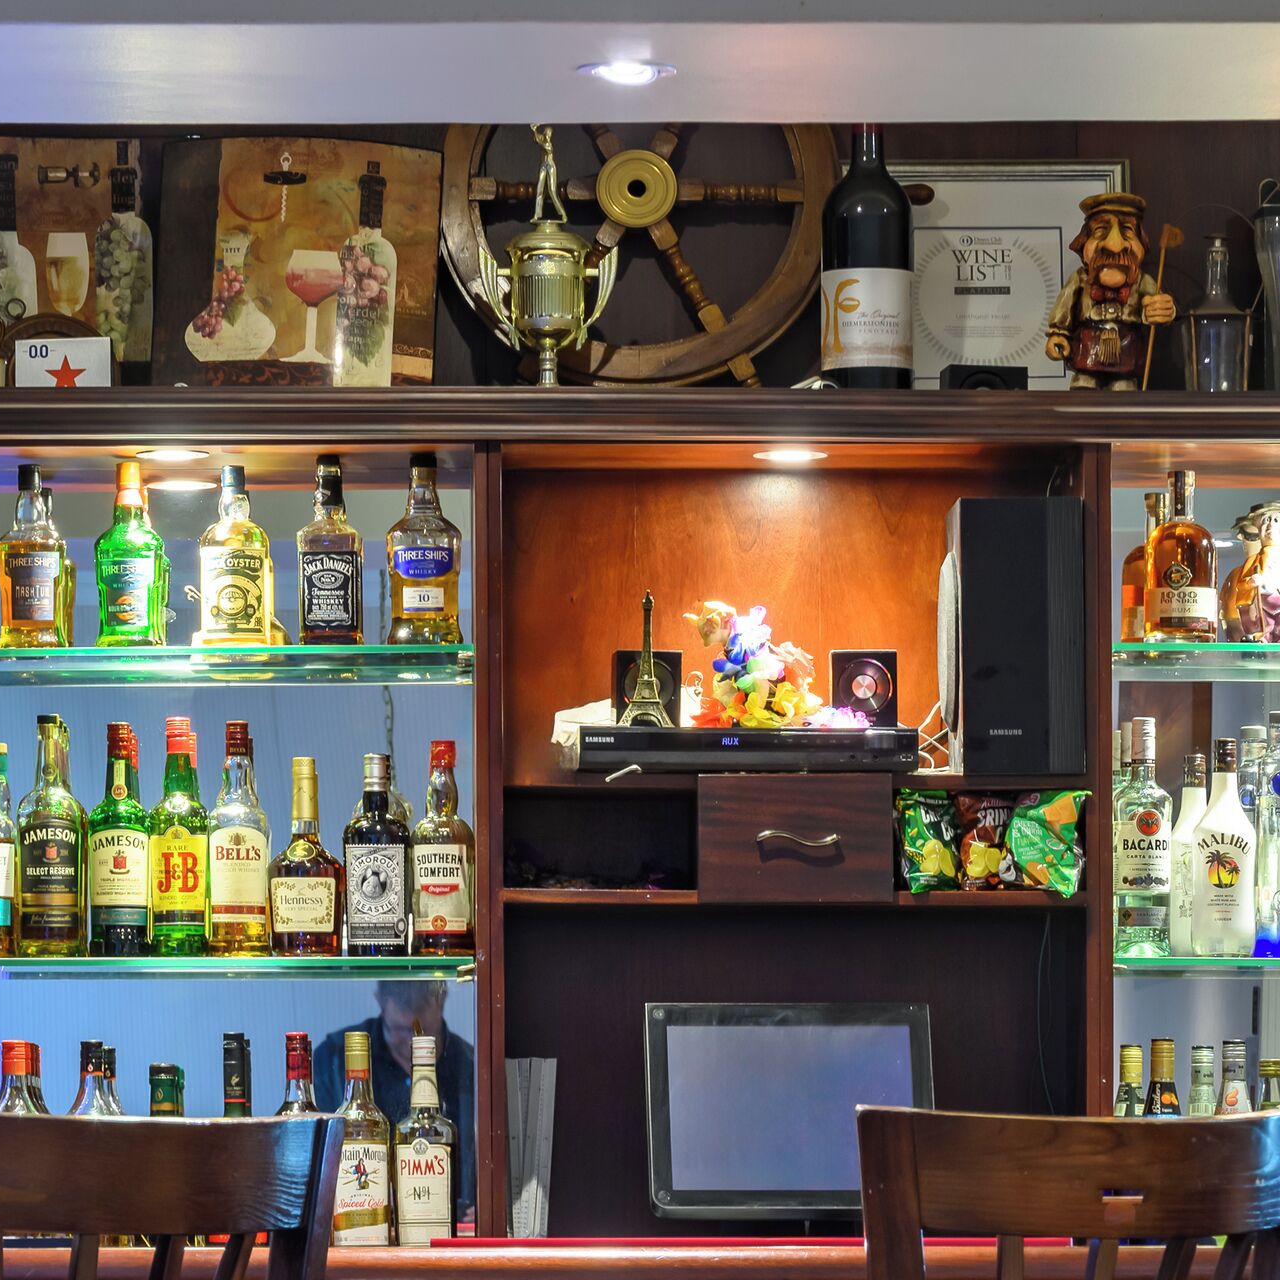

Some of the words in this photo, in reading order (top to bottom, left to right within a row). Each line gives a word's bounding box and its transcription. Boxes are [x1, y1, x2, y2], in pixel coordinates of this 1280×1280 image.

[952, 249, 1013, 264] WINE
[957, 264, 1001, 281] LIST
[8, 557, 33, 569] THREE
[397, 550, 422, 563] THREE
[422, 550, 449, 562] SHIPS
[226, 558, 261, 569] OYSTER
[303, 559, 323, 576] JACK
[323, 557, 353, 576] DANIEL'S
[311, 588, 345, 596] Tennessee
[417, 594, 430, 603] 10
[1160, 591, 1198, 599] 1000
[722, 738, 739, 746] AUX
[24, 828, 76, 845] JAMESON
[92, 834, 146, 852] JAMESON
[1198, 832, 1251, 856] MALIBU
[215, 845, 261, 862] BELL'S
[416, 853, 462, 866] SOUTHERN
[26, 867, 48, 876] SELECT
[49, 867, 75, 876] RESERVE
[352, 857, 397, 874] TIMOROUS
[157, 852, 199, 894] J&B
[419, 867, 460, 878] COMFORT
[279, 894, 324, 906] Hennessy
[355, 899, 395, 913] BEASTIE
[400, 1155, 445, 1176] PIMM'S
[338, 1198, 365, 1209] Spiced
[367, 1198, 385, 1209] Gold
